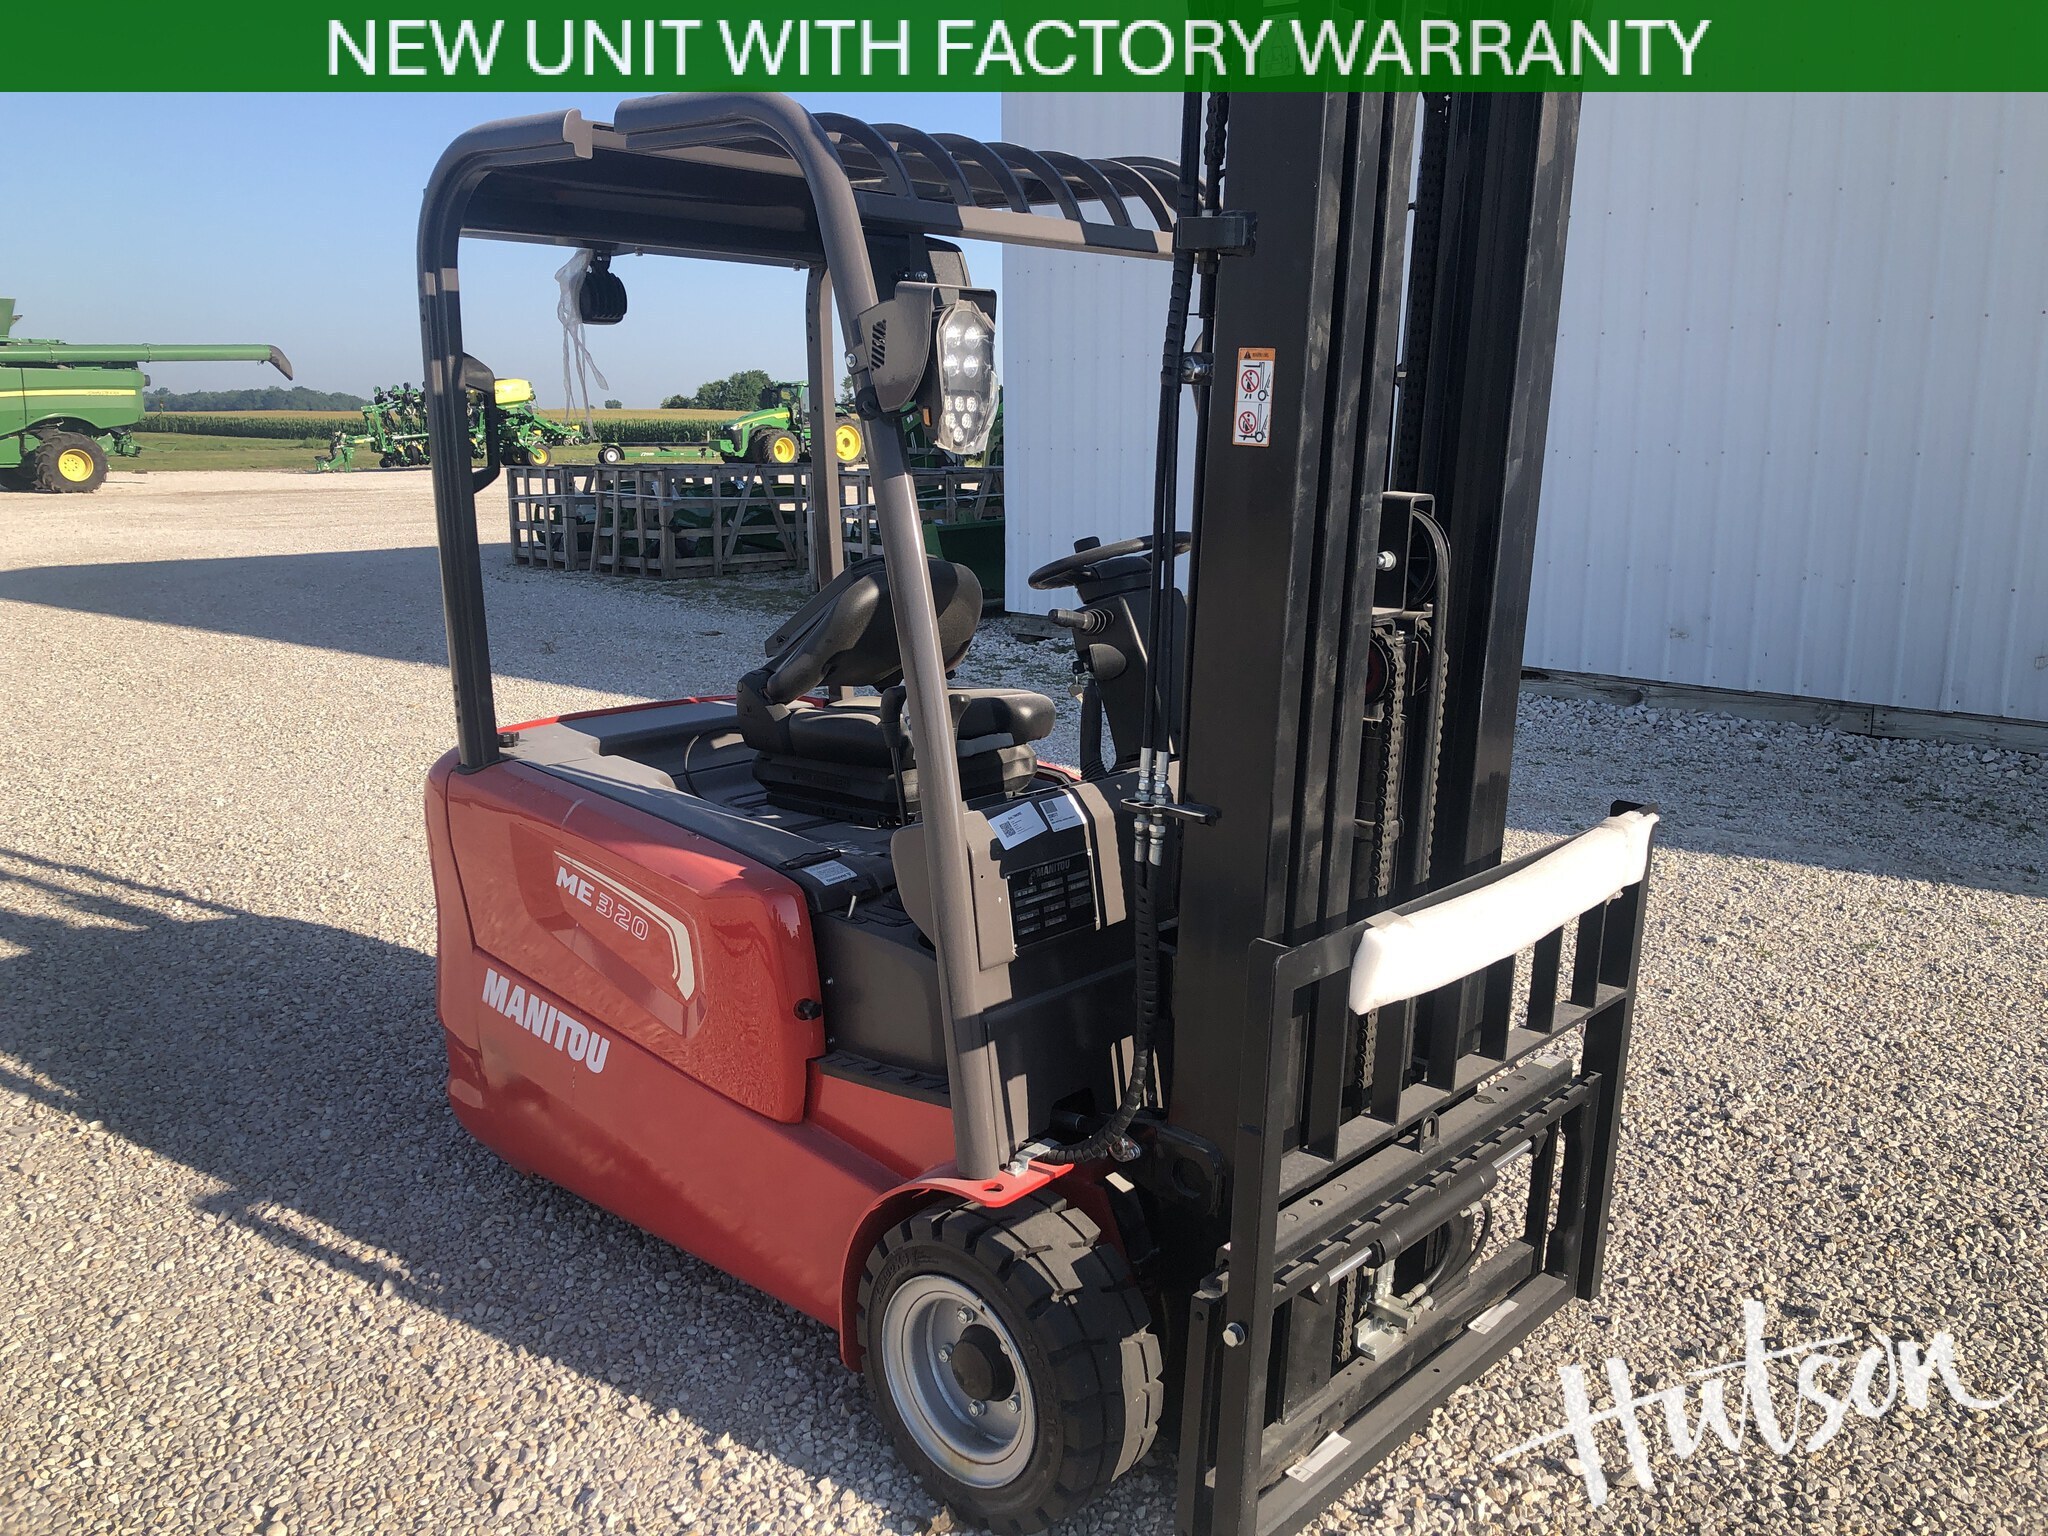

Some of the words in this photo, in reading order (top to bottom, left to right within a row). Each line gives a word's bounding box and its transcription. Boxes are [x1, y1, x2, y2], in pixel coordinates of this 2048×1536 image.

[555, 866, 595, 907] ME
[595, 892, 649, 941] 320
[1036, 858, 1071, 878] MANITOU
[481, 967, 611, 1075] MANITOU
